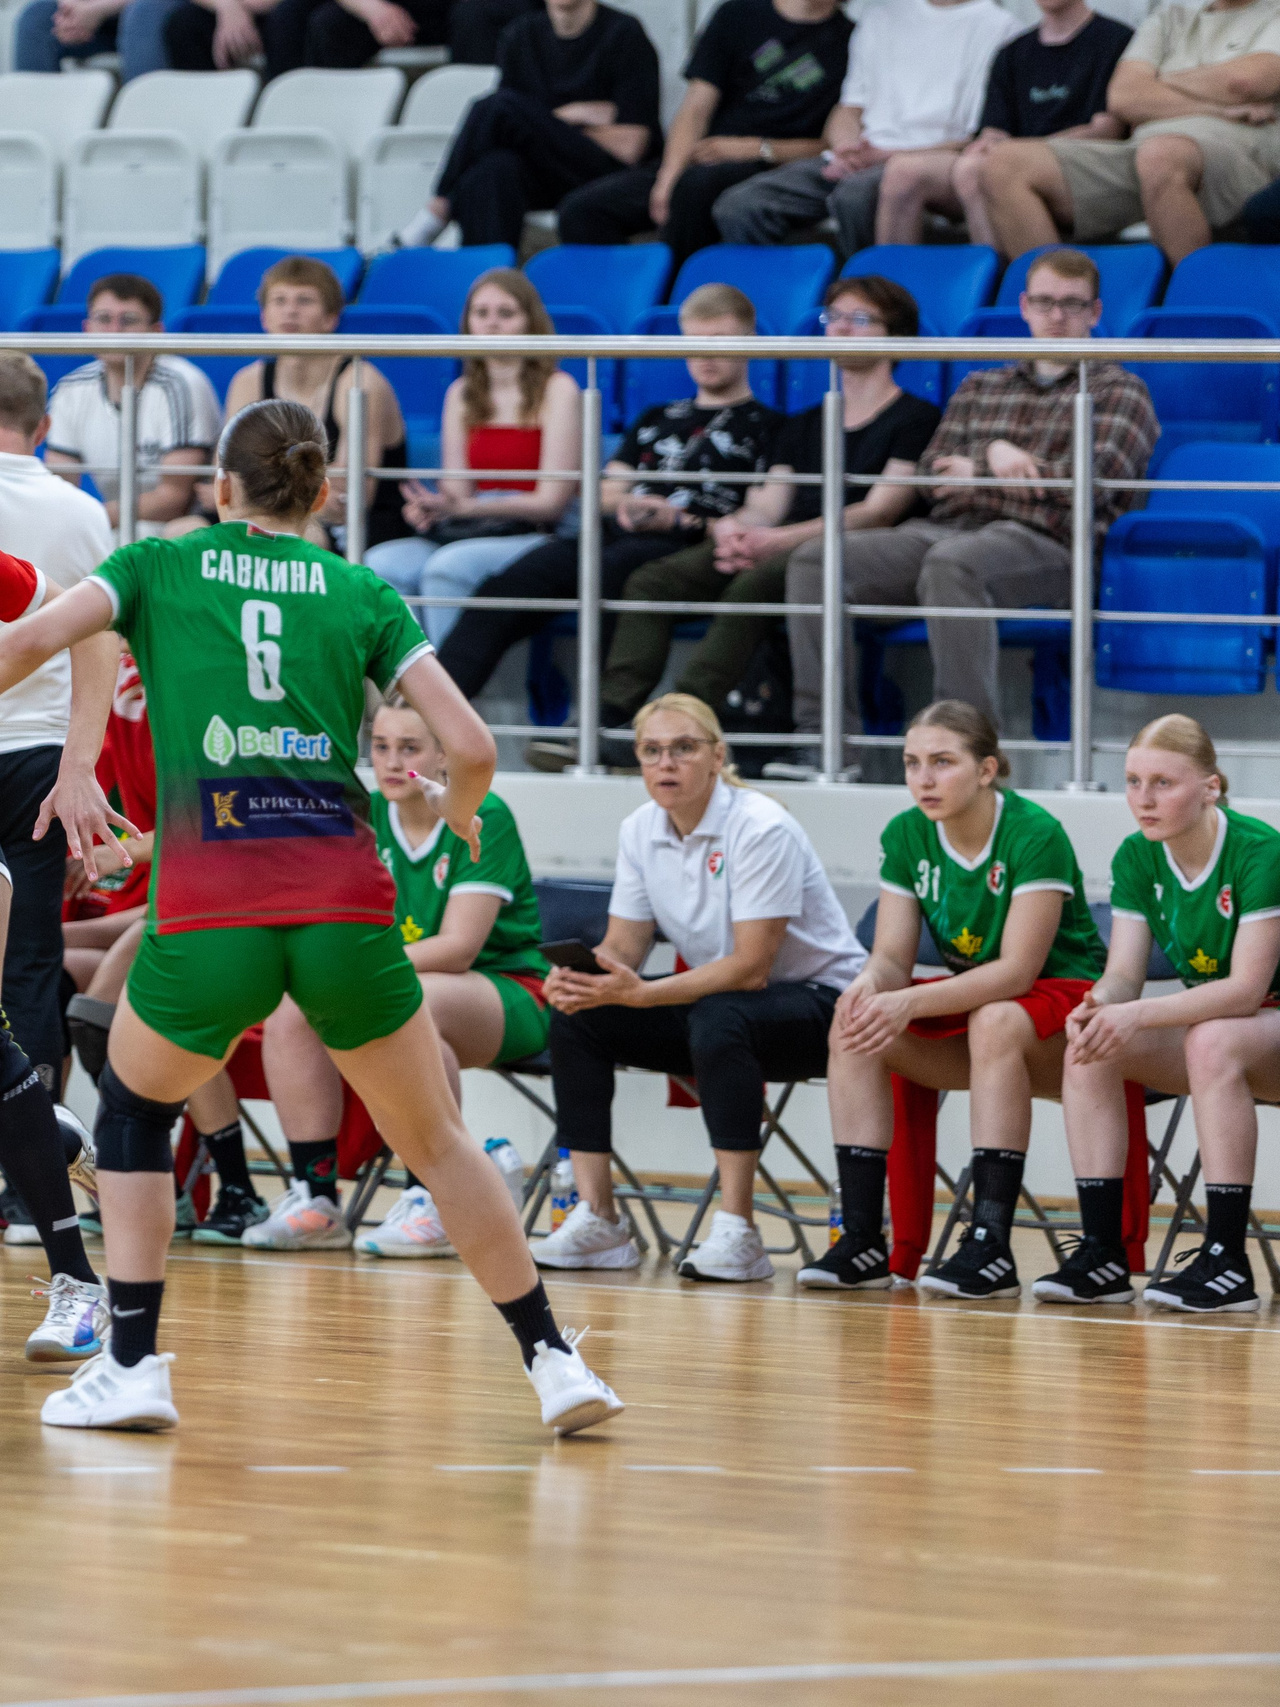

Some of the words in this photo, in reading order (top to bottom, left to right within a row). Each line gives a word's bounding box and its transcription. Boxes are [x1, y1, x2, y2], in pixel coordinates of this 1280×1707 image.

[201, 548, 327, 596] САВКИНА
[240, 599, 286, 702] 6
[238, 726, 330, 760] BelFert
[914, 858, 942, 903] 31
